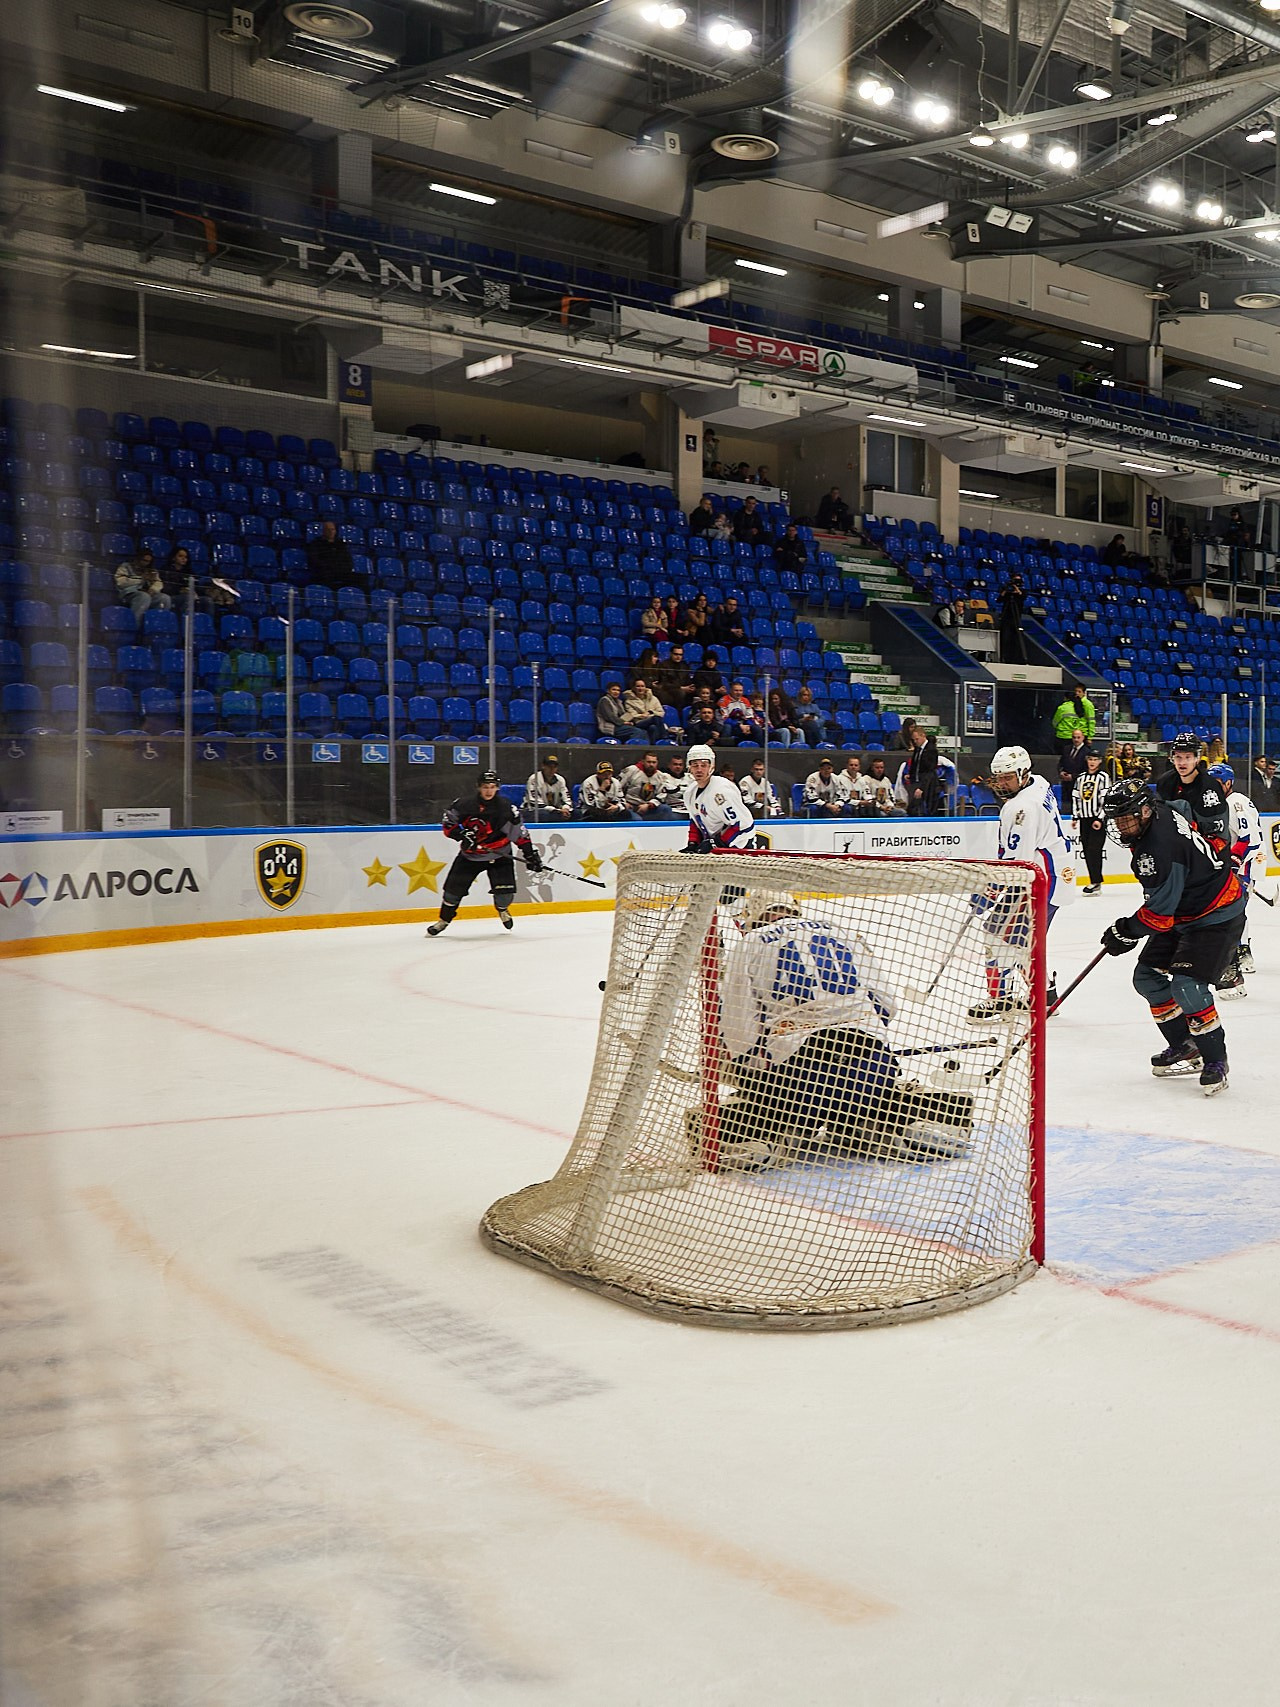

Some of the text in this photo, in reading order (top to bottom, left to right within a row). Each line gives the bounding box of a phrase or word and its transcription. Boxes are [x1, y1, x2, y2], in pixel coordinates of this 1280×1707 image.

[232, 15, 251, 28] 10
[669, 137, 676, 149] 9
[971, 228, 977, 238] 8
[280, 237, 468, 302] TANK
[735, 337, 818, 368] SPAR
[349, 364, 362, 387] 8
[1071, 410, 1121, 432] ЧЕМПИОНАТ
[1122, 424, 1154, 439] РОССИИ
[687, 437, 695, 448] 1
[780, 490, 788, 501] 5
[1151, 501, 1158, 516] 9
[724, 803, 738, 820] 15
[1238, 817, 1249, 830] 19
[871, 835, 961, 848] ПРАВИТЕЛЬСТВО
[264, 847, 298, 876] ОХЛ
